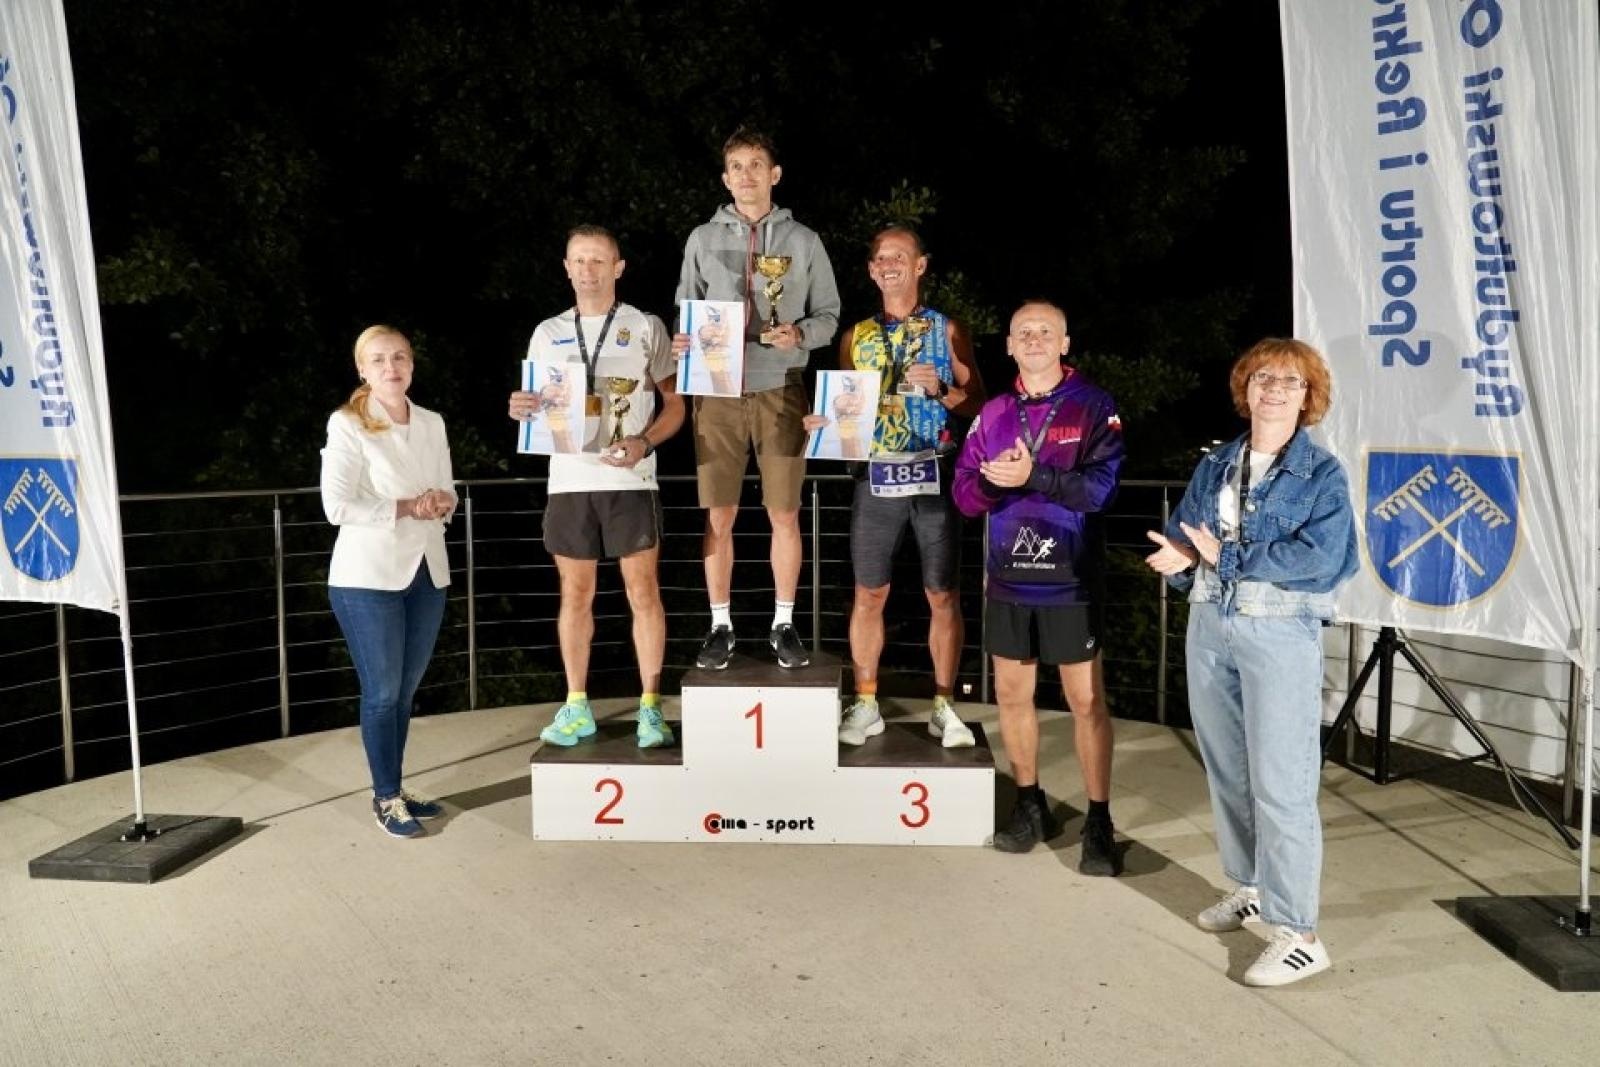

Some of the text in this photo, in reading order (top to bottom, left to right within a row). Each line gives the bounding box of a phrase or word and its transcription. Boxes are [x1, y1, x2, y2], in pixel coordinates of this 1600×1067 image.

[1047, 426, 1082, 441] RUN
[882, 463, 926, 484] 185
[743, 701, 764, 749] 1
[594, 778, 624, 824] 2
[899, 782, 930, 829] 3
[766, 816, 815, 834] sport
